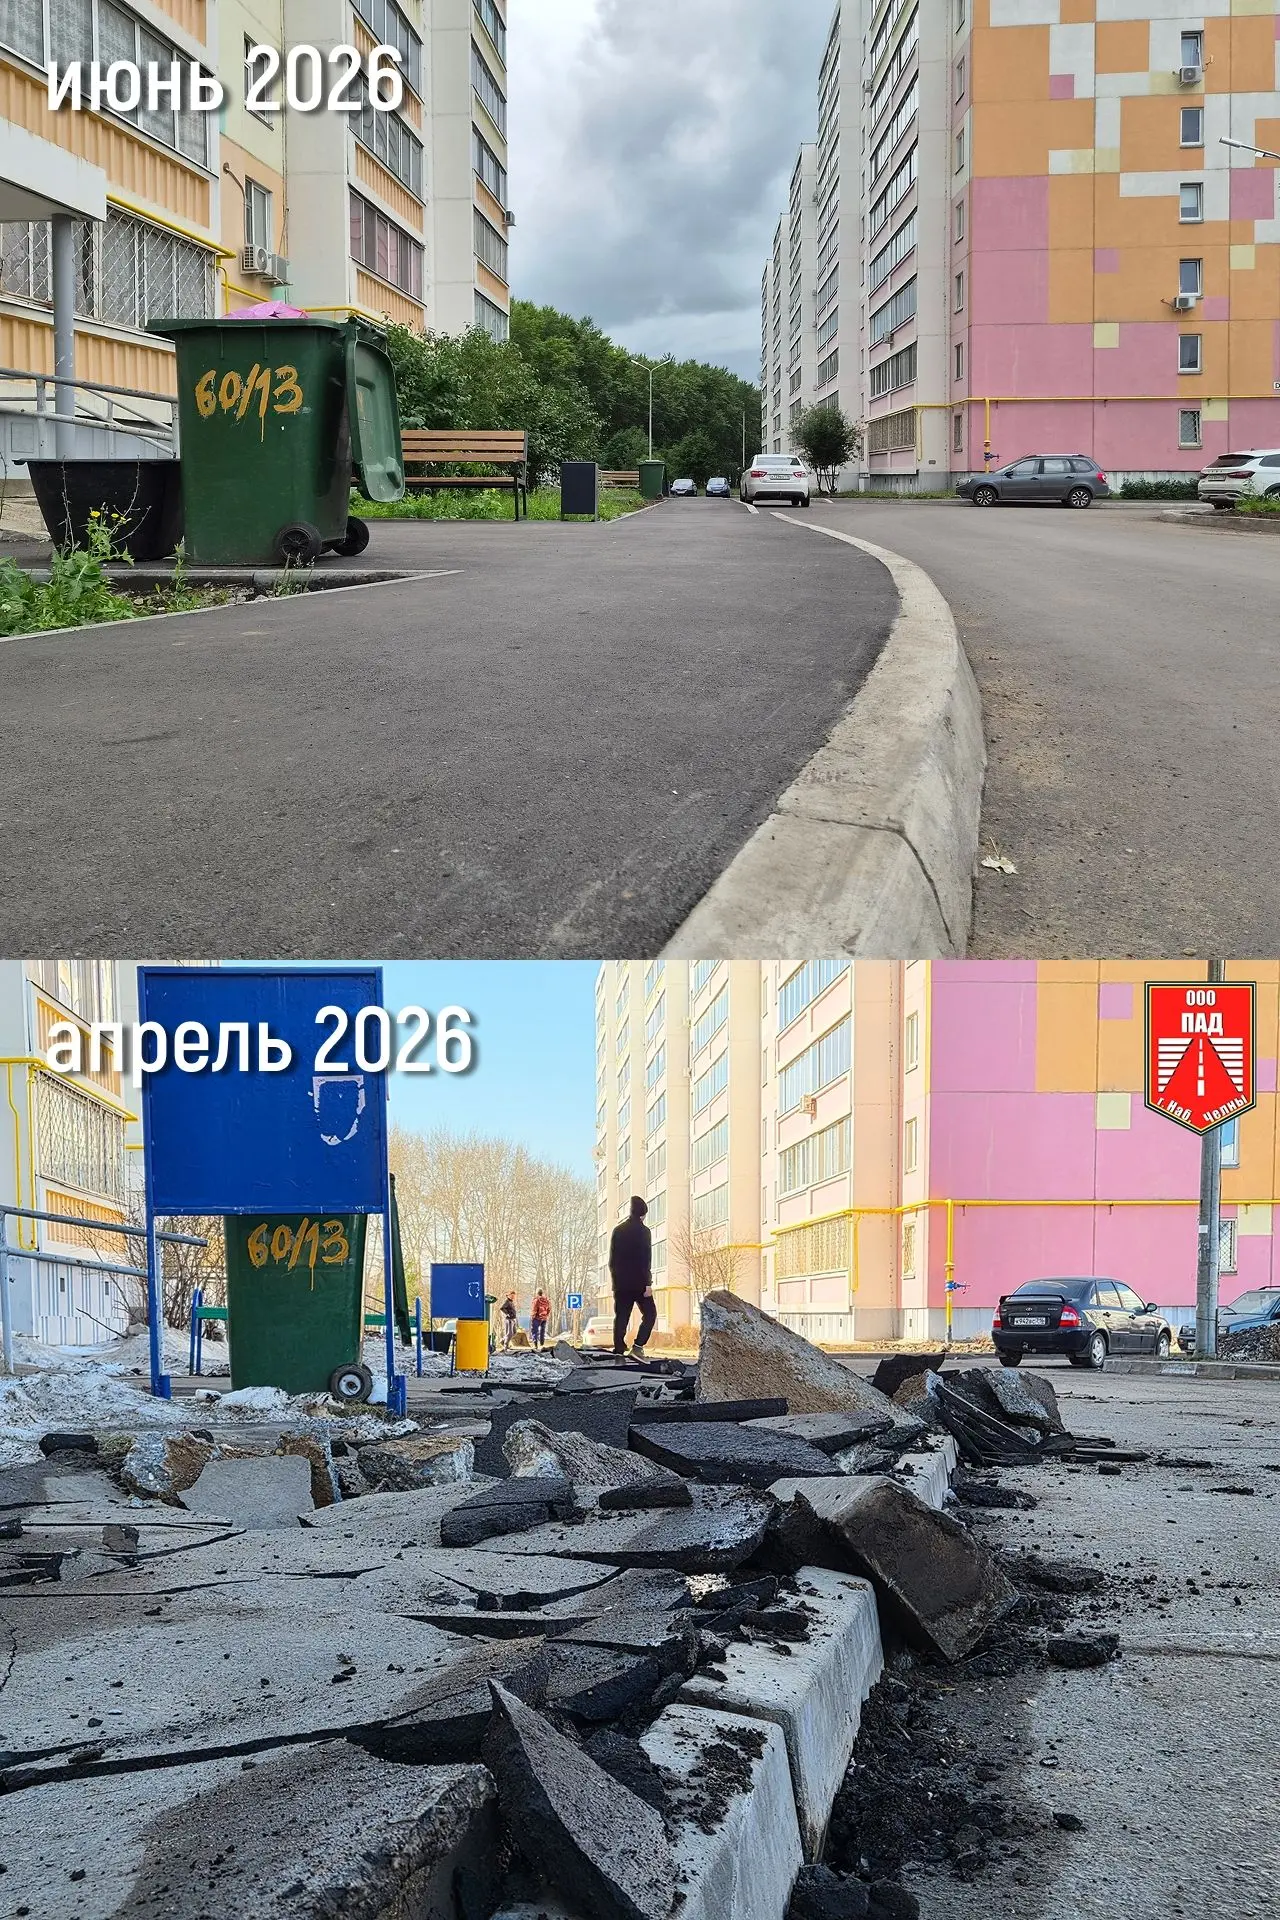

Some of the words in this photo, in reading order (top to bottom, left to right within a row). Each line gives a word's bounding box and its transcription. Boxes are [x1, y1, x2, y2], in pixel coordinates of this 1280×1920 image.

[195, 363, 304, 421] 60/13
[247, 1216, 349, 1272] 60/13
[570, 1296, 579, 1309] P
